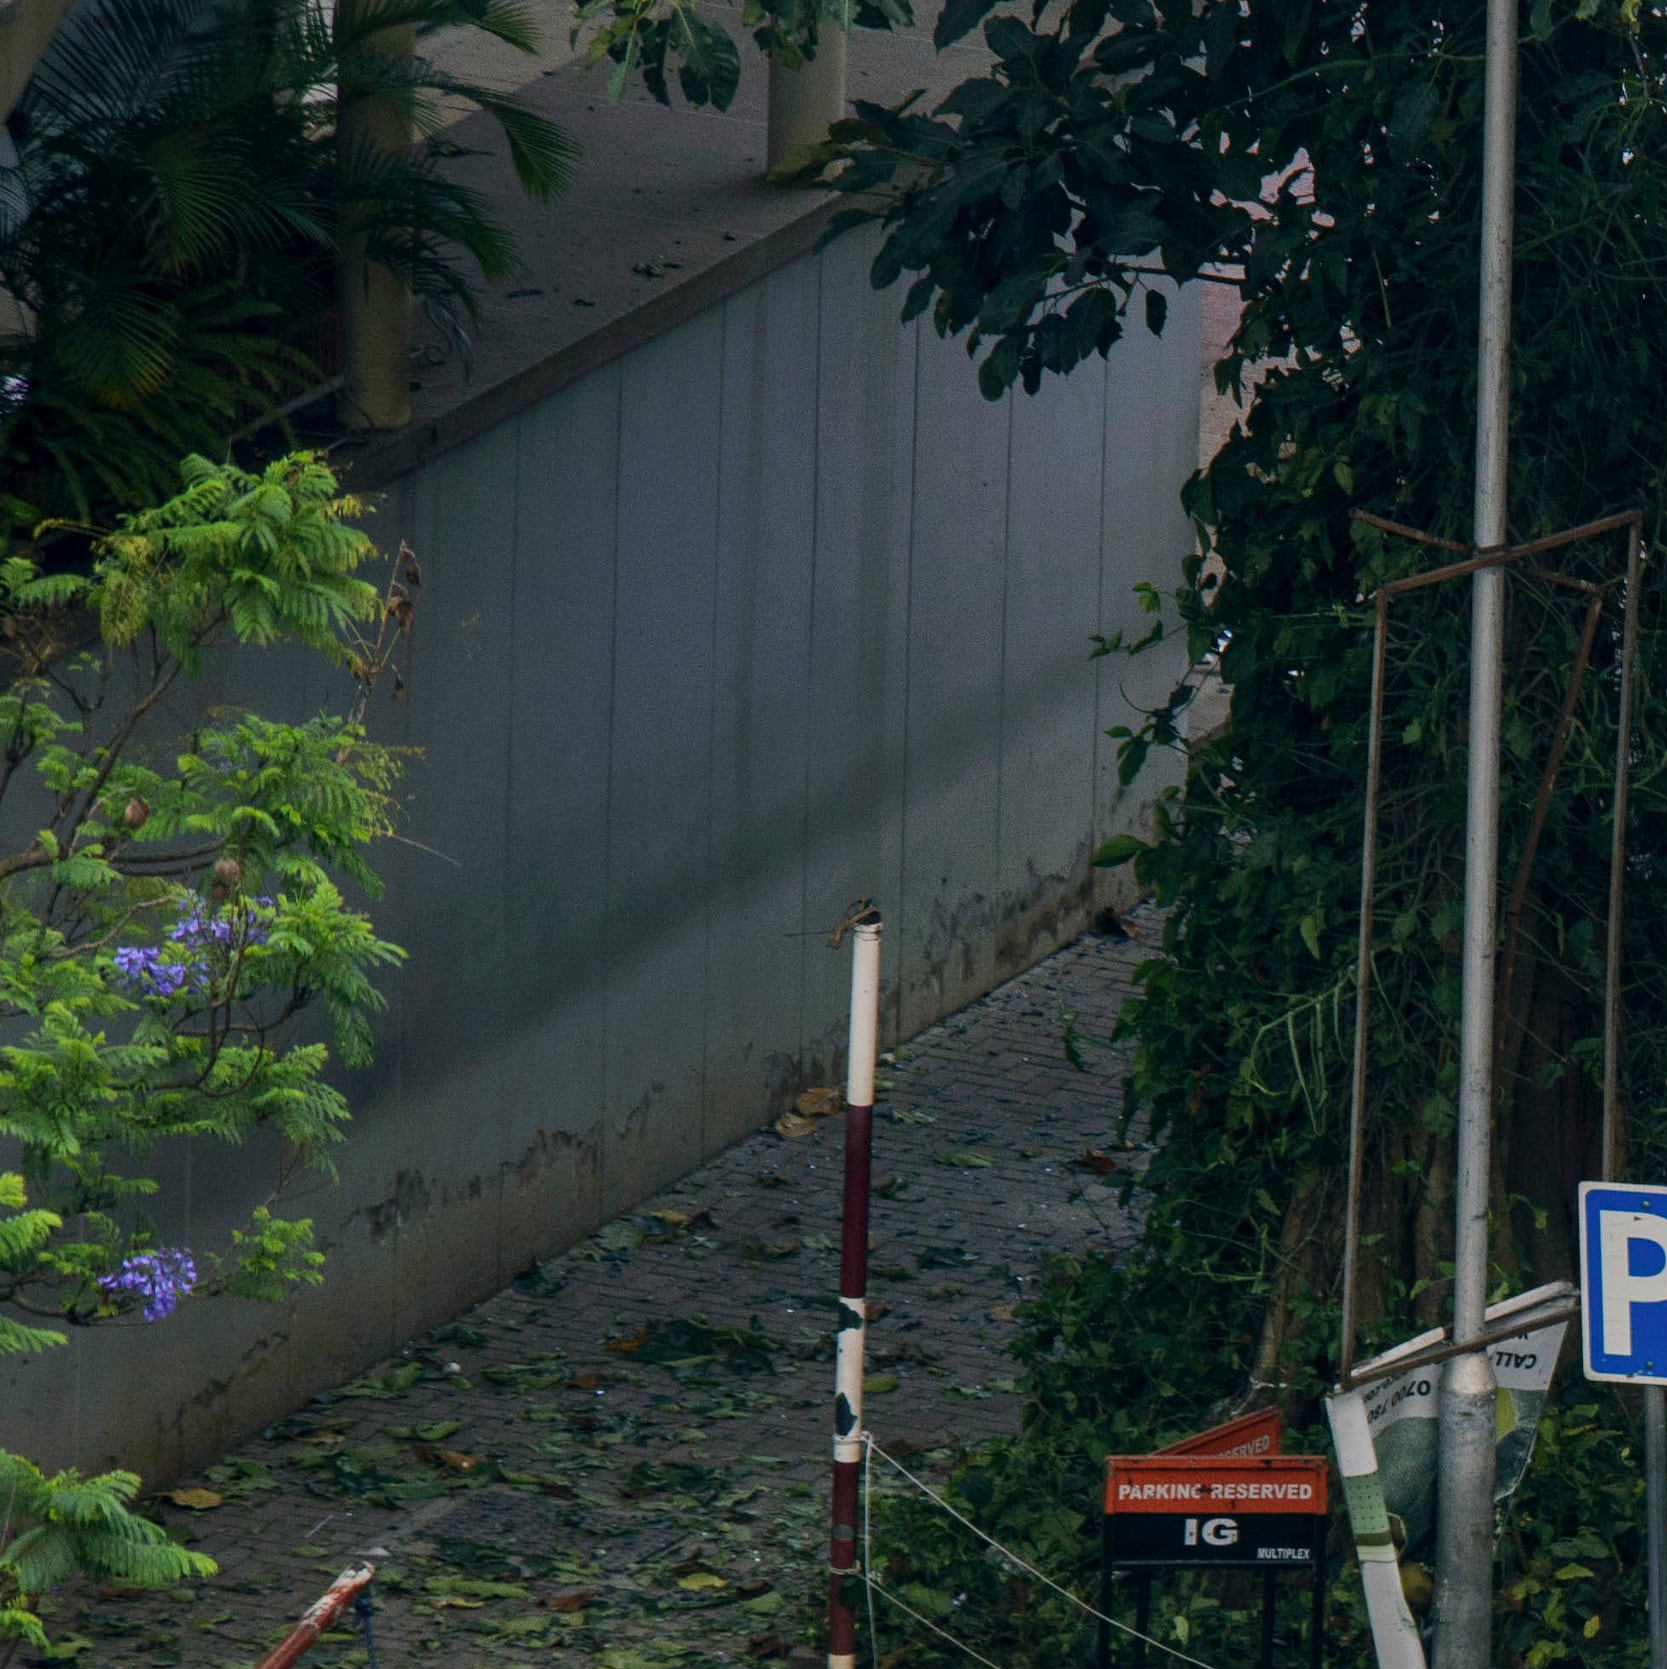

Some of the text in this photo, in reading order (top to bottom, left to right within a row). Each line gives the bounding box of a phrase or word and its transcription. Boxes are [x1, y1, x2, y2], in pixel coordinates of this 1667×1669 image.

[1495, 1351, 1537, 1369] CALL
[1118, 1483, 1312, 1500] PARKING RESERVED
[1183, 1517, 1240, 1547] IG
[1257, 1547, 1311, 1560] MULTIPLEX
